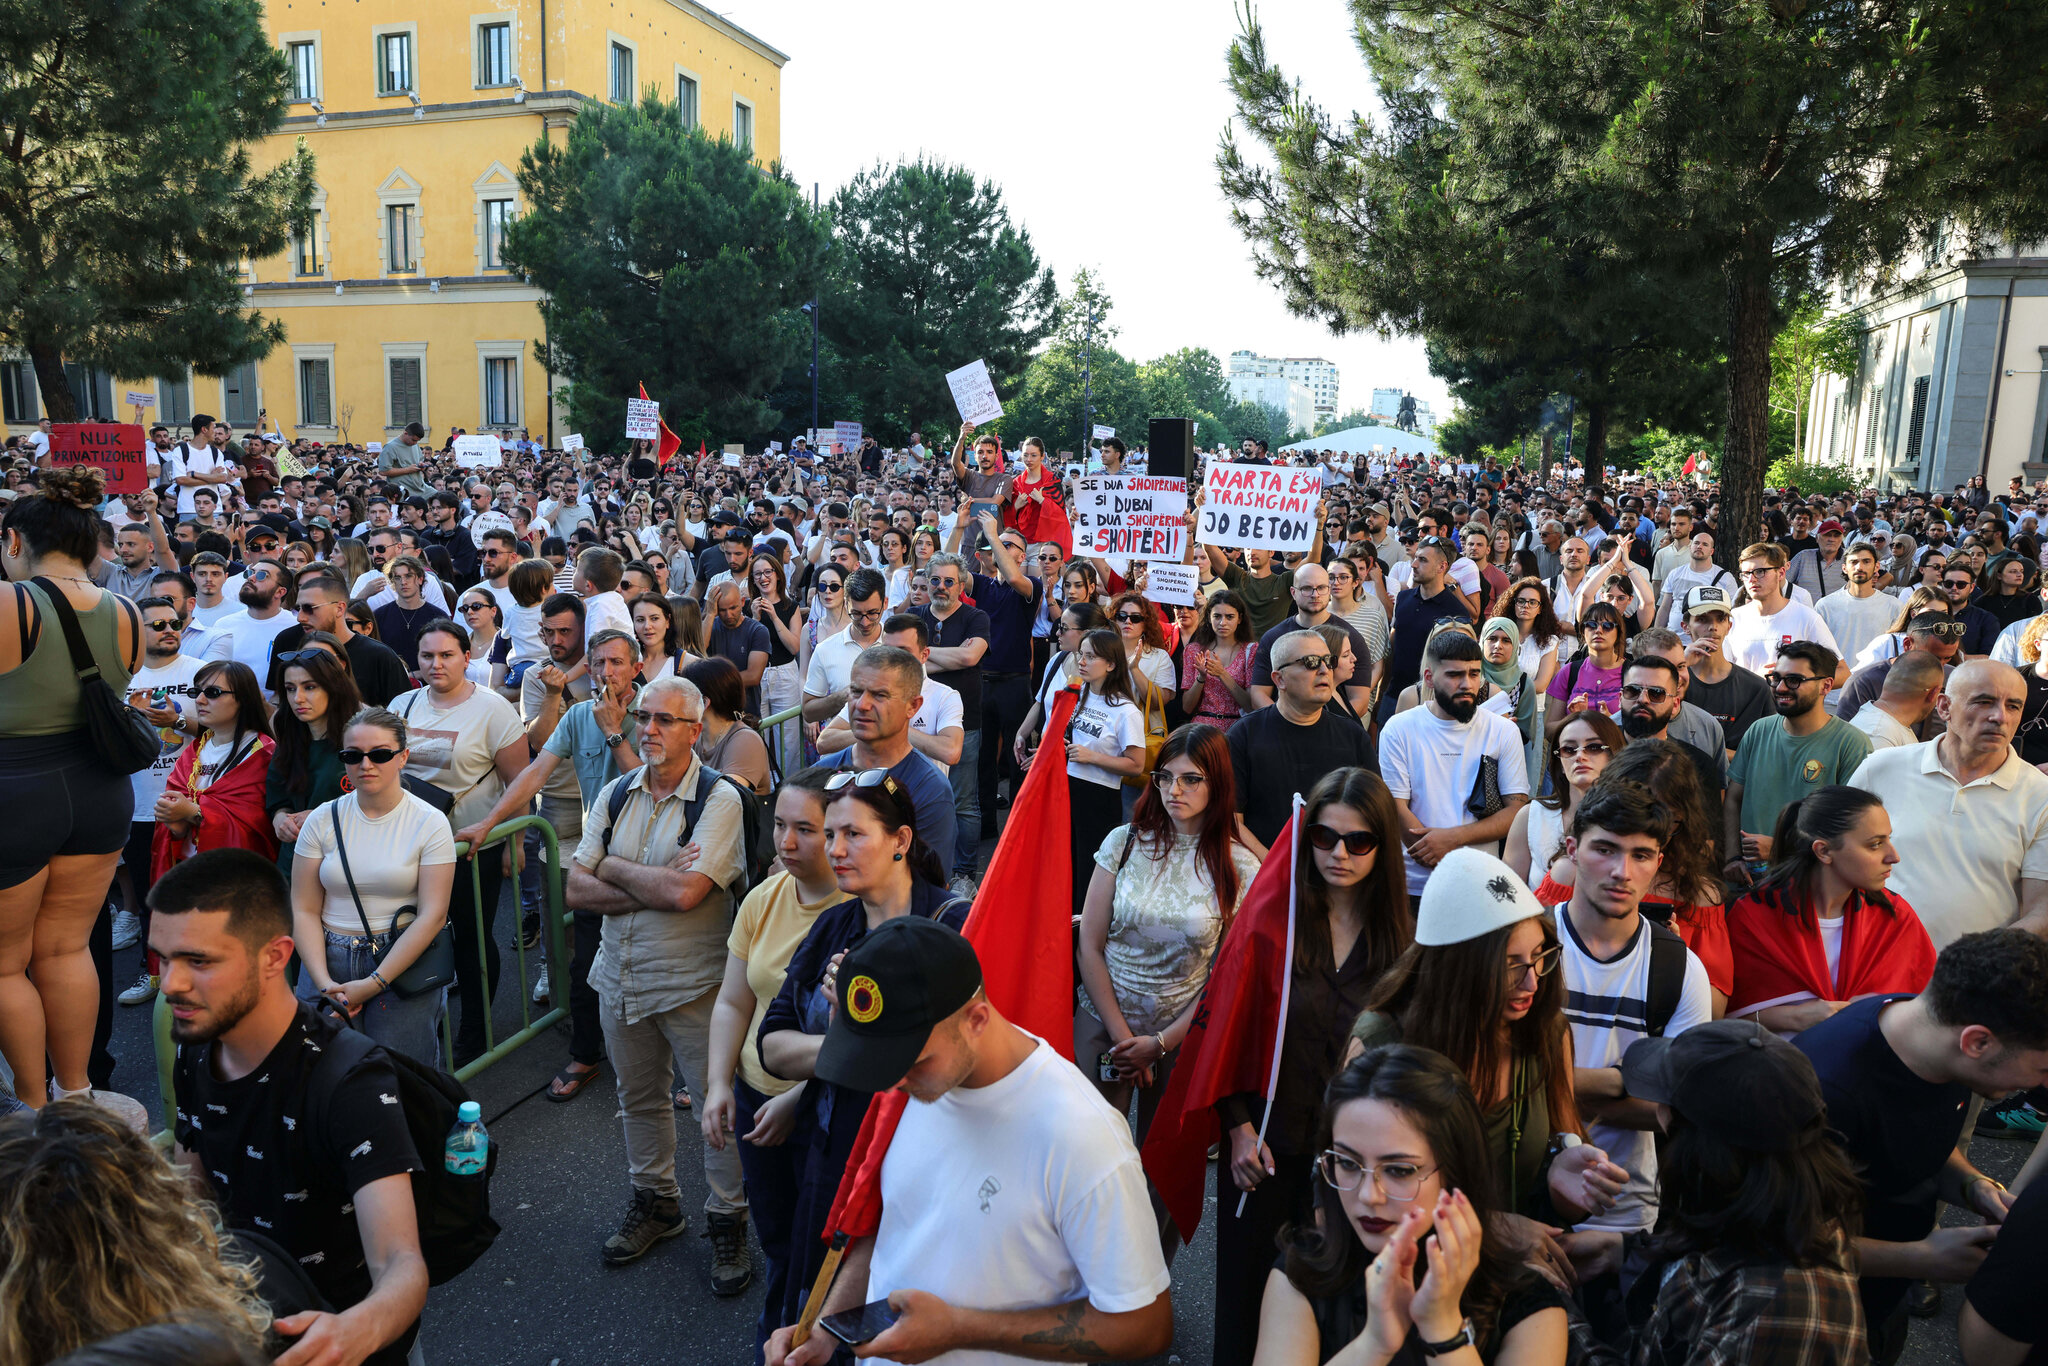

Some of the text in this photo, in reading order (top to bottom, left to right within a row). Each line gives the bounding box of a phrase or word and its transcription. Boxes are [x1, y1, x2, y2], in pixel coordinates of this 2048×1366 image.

[80, 431, 122, 446] NUK
[53, 450, 144, 464] PRIVATIZOHET
[1080, 477, 1186, 493] SE DUA SHQIPËRINË
[1209, 467, 1282, 493] NARTA
[1211, 488, 1309, 514] TRASHGIMI
[1080, 513, 1089, 527] E
[1097, 513, 1122, 526] DUA
[1204, 511, 1308, 541] JO BETON
[1165, 586, 1188, 594] PARTIA!
